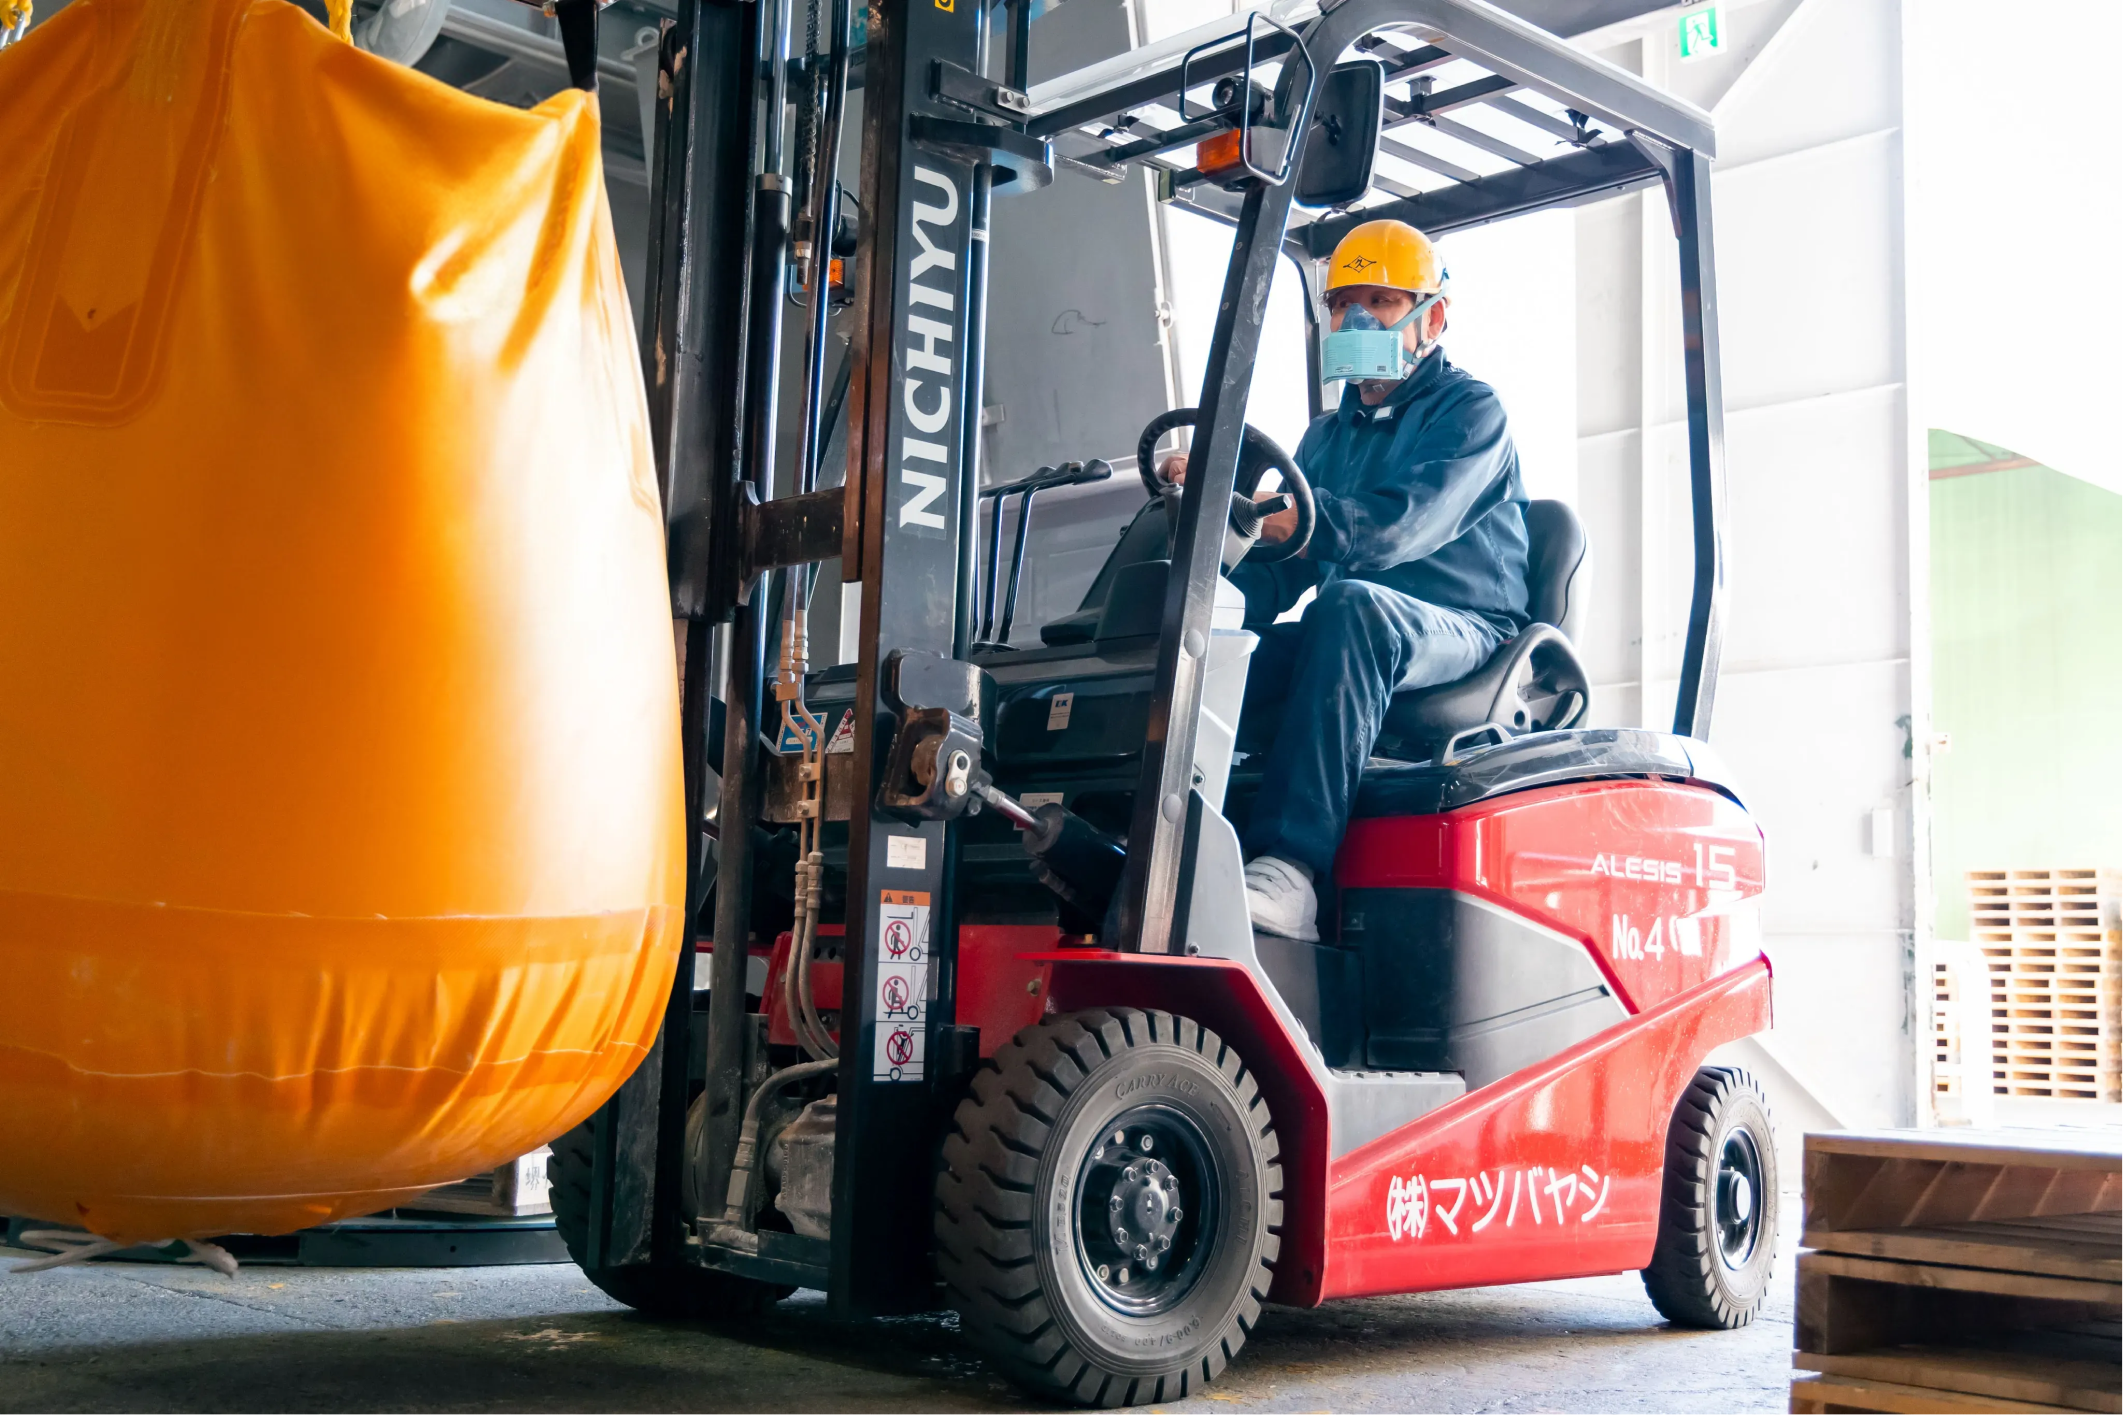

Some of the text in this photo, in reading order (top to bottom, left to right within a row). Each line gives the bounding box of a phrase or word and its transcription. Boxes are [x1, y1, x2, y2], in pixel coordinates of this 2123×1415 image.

[899, 165, 959, 530] NICHIYU
[1590, 843, 1736, 890] ALESIS 15
[1115, 1073, 1200, 1101] CARRY ACE
